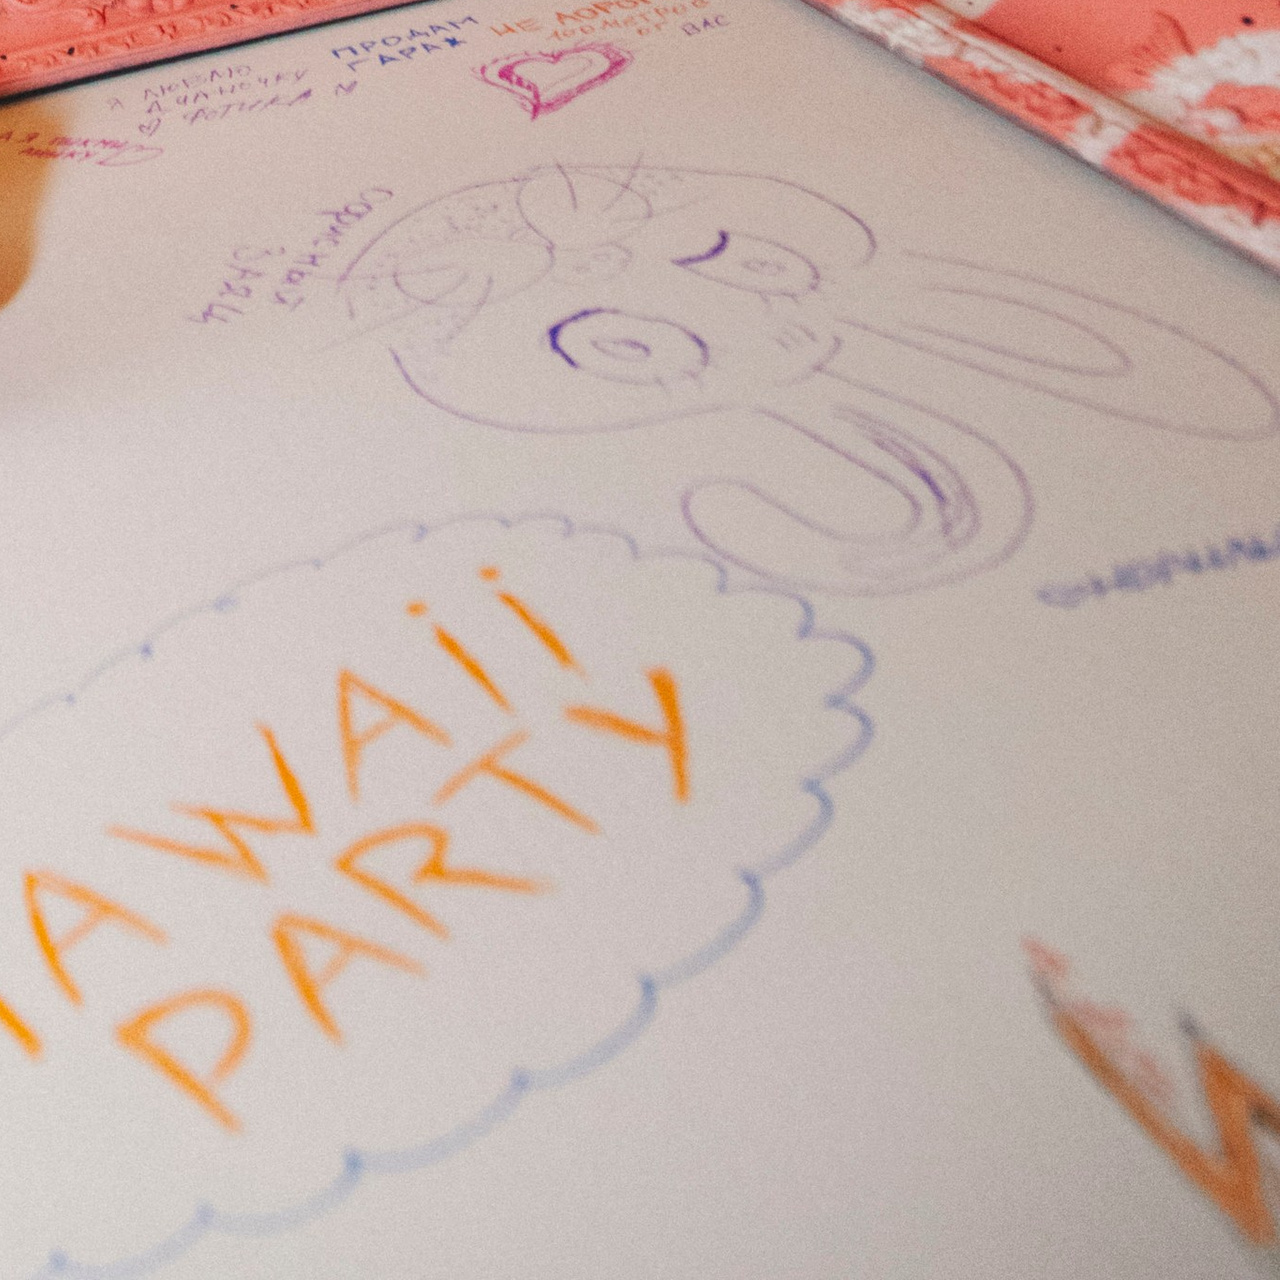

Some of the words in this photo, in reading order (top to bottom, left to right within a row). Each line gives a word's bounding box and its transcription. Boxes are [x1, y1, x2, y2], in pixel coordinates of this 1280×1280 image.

[330, 14, 479, 59] ПРОДАМ
[489, 17, 542, 38] НЕ
[346, 35, 467, 72] ГАРАЖ
[115, 667, 690, 1132] PARTY
